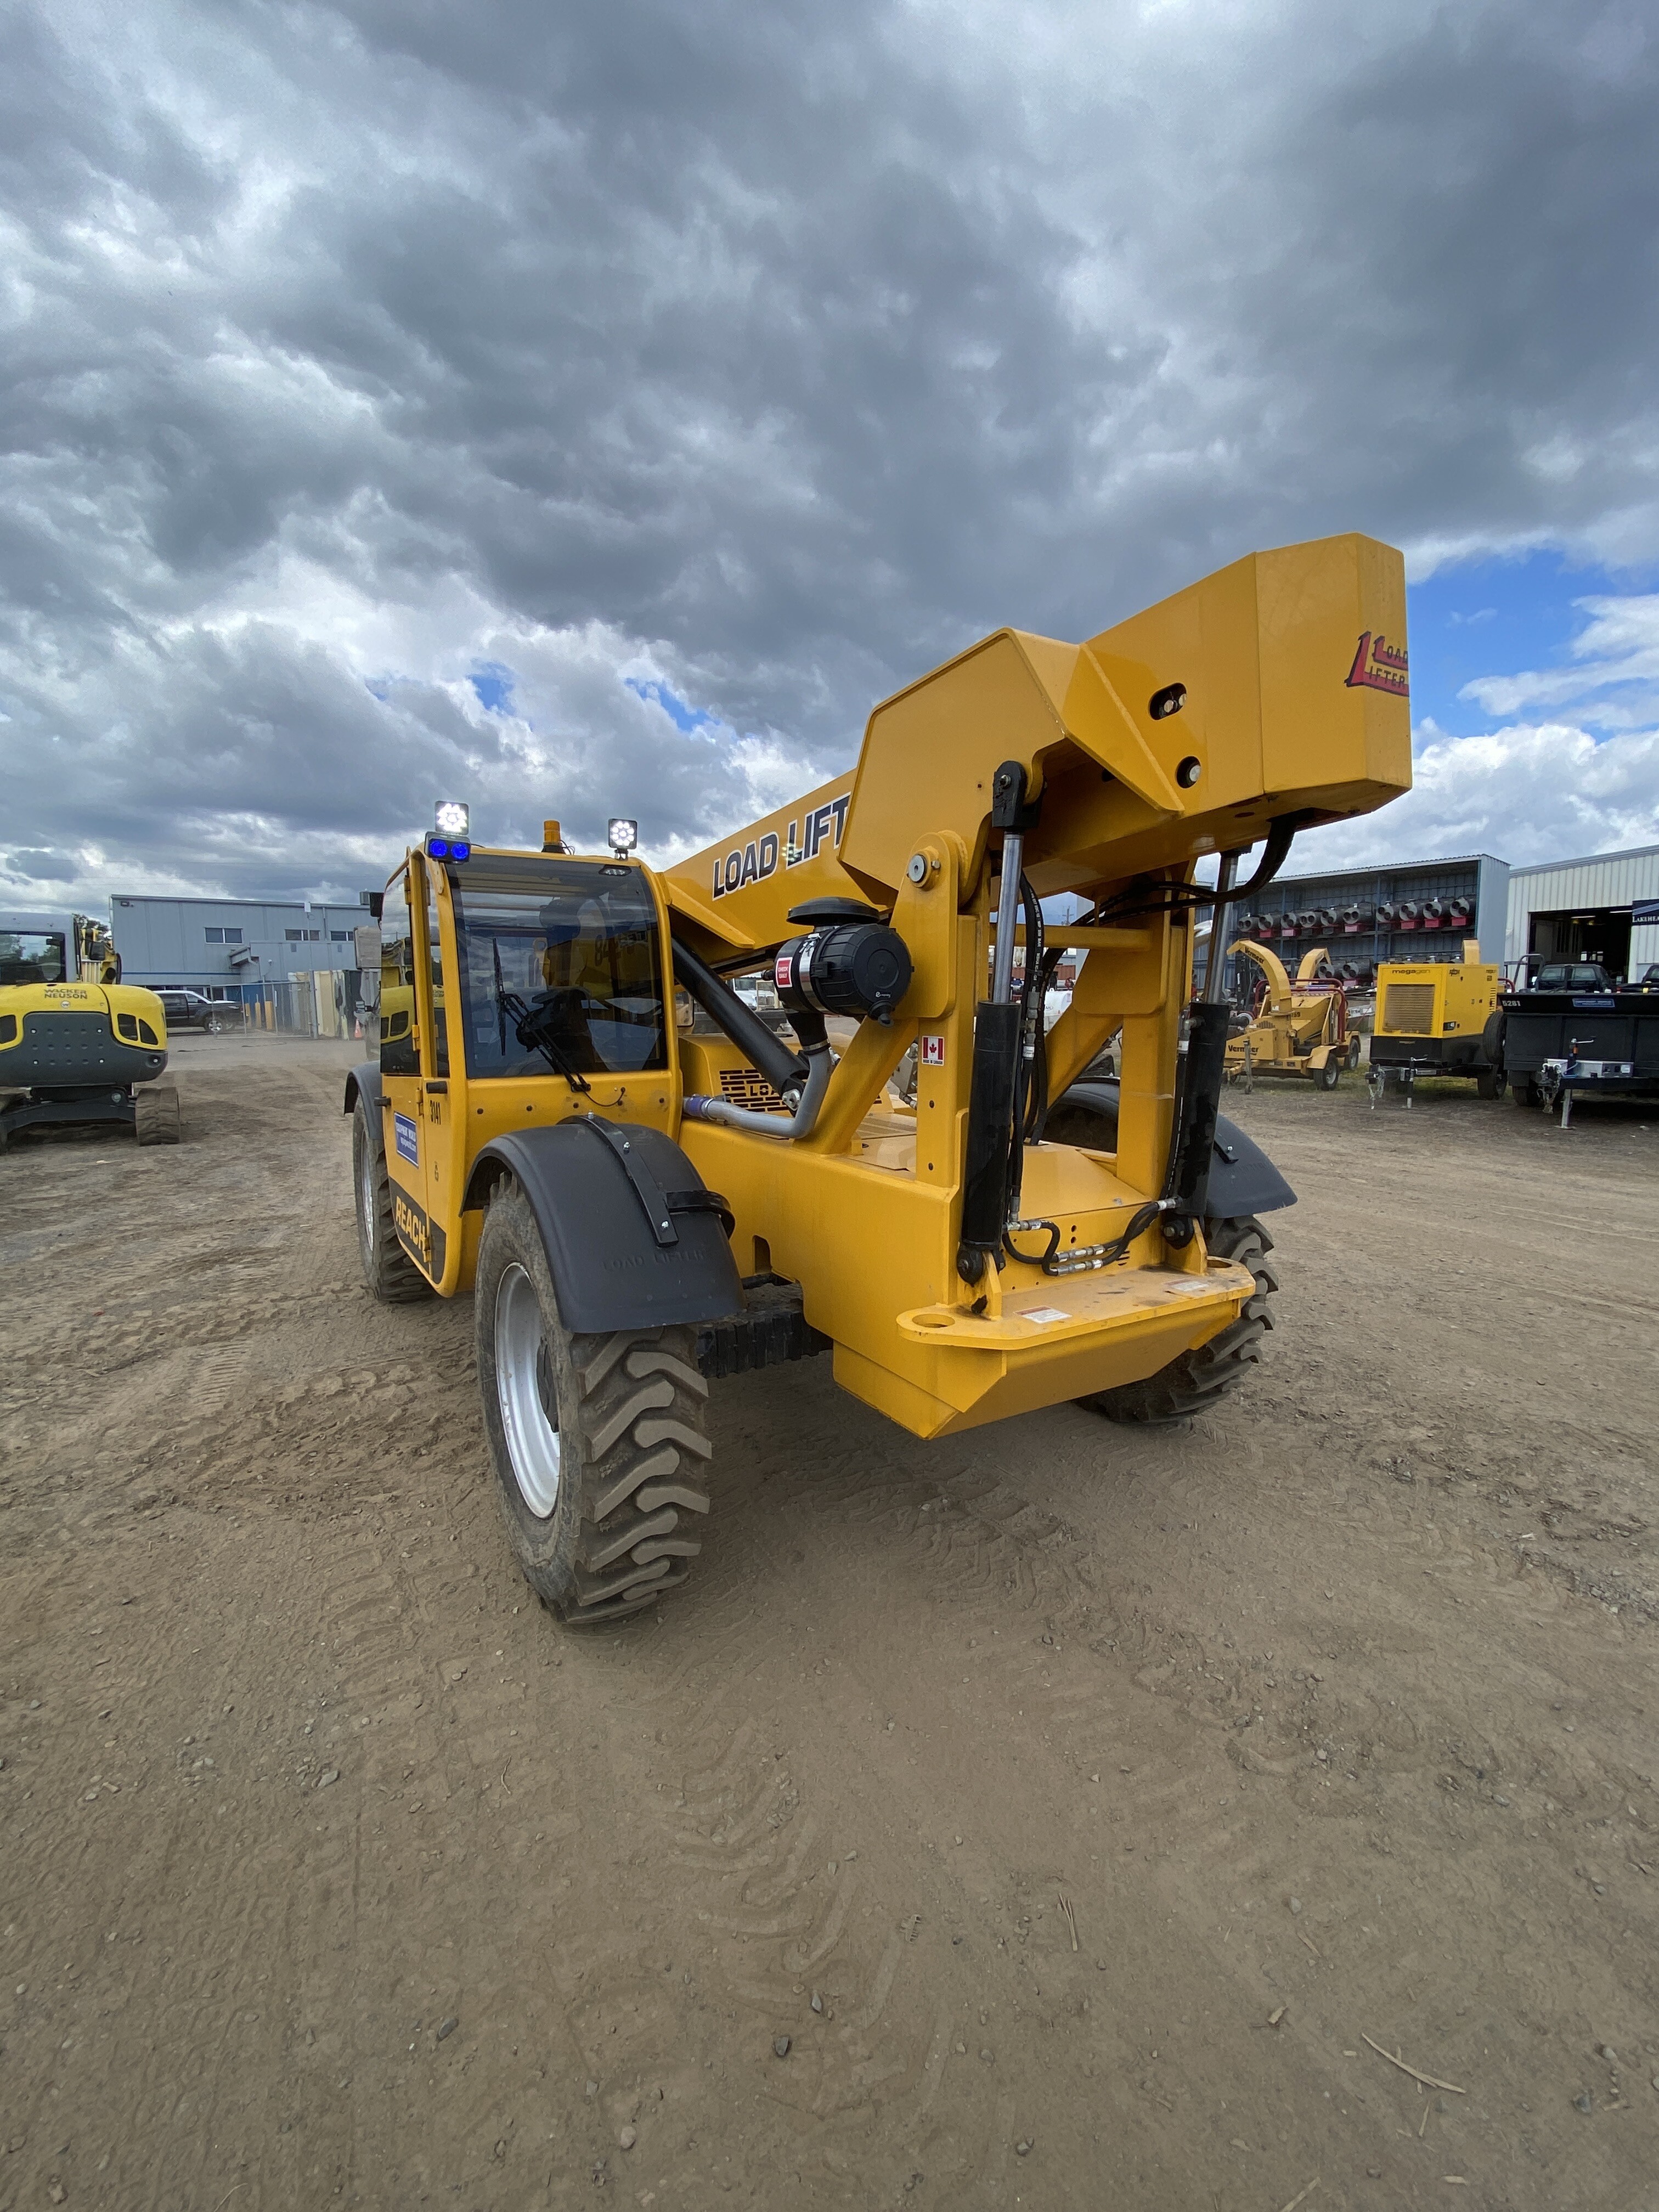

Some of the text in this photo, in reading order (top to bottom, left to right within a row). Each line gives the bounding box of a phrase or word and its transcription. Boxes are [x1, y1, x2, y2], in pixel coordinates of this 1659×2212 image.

[712, 791, 851, 901] LOAD LIFT
[1228, 1045, 1260, 1053] Vermer
[430, 1099, 441, 1125] 3141
[396, 1195, 426, 1255] REACH
